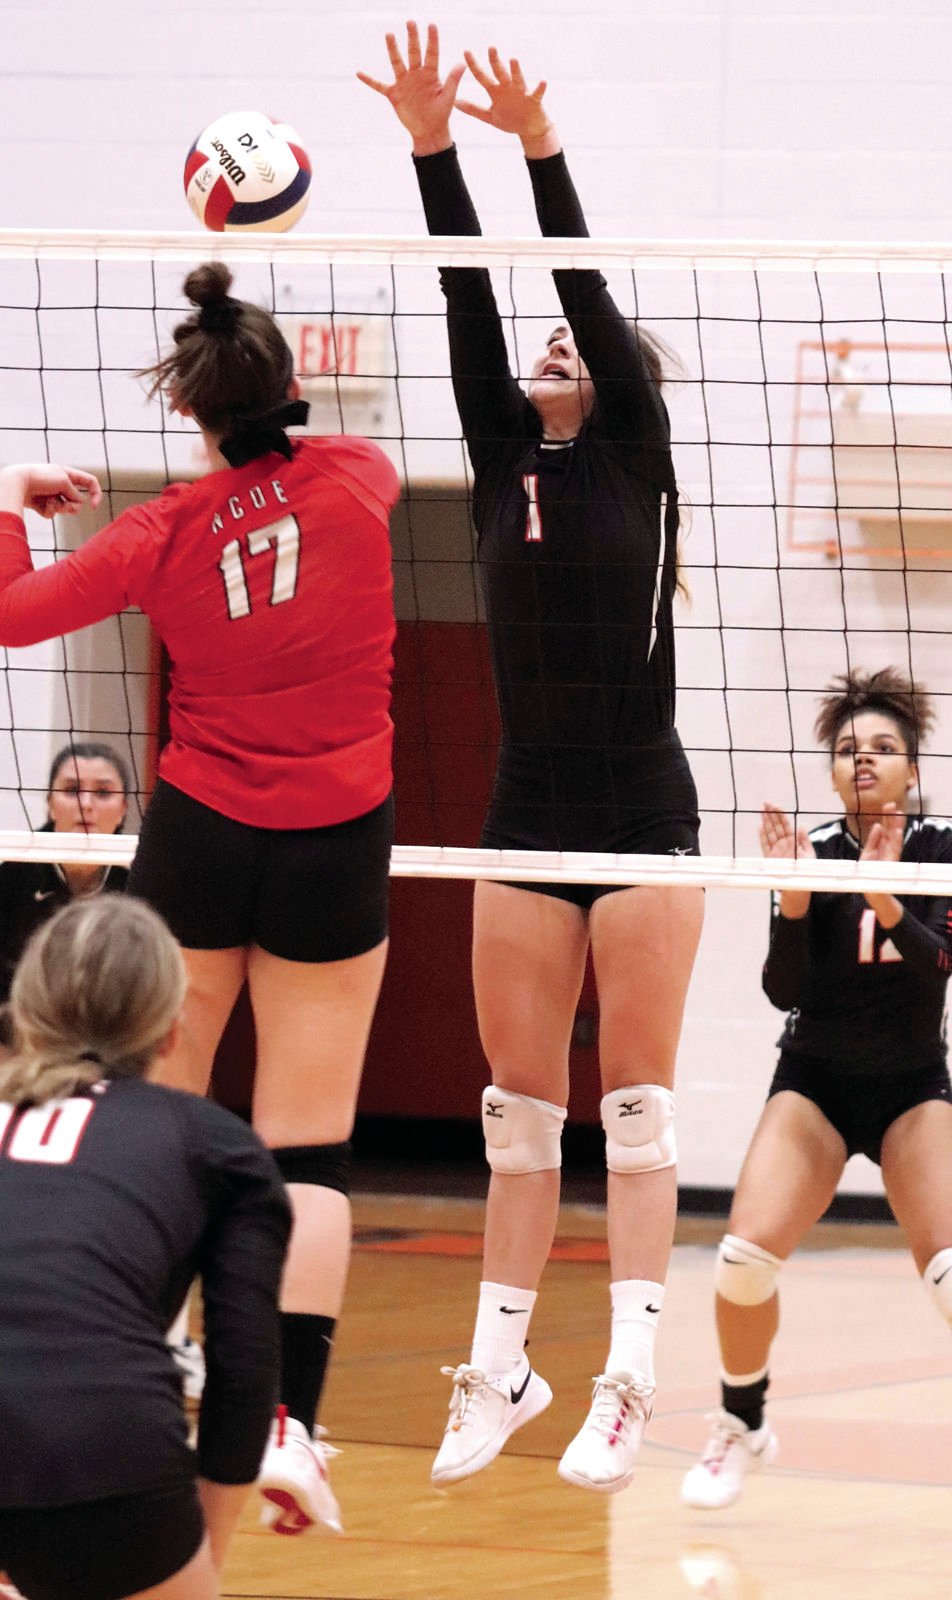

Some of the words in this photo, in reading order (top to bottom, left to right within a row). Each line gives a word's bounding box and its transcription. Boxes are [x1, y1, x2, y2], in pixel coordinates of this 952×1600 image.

[299, 324, 362, 376] EXIT
[521, 473, 544, 542] 1
[218, 512, 302, 621] 17
